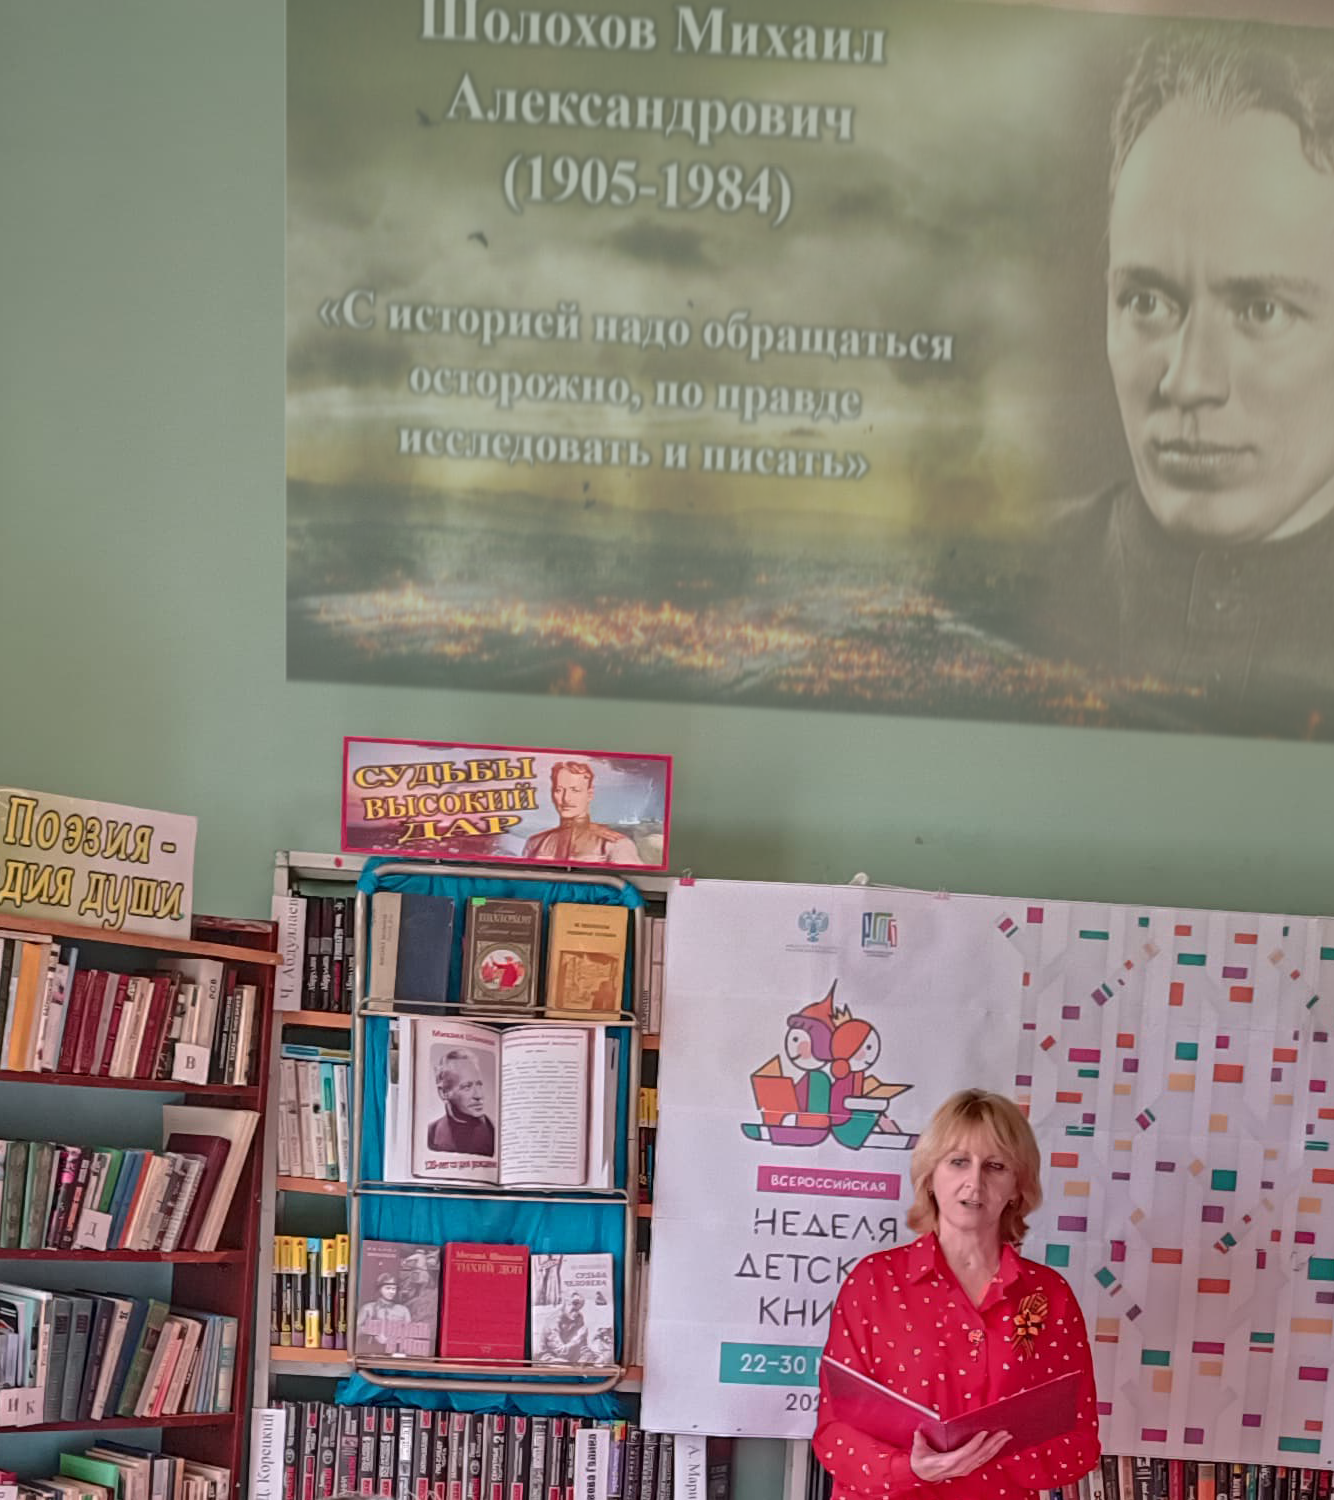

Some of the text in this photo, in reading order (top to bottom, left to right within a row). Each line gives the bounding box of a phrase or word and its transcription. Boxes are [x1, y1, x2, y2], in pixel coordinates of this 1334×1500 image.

[419, 0, 887, 67] Шолохов Михаил
[447, 71, 856, 144] Александрович
[503, 152, 793, 223] (1905-1984)
[318, 289, 955, 366] «С историей надо обращаться
[409, 361, 861, 423] осторожно, по правде
[399, 421, 870, 481] исследовать и писать»
[354, 757, 536, 790] СУДЬБЫ
[363, 786, 538, 820] ВЫСОКИЙ
[4, 795, 153, 864] Поэзия
[398, 814, 523, 844] ДАР
[80, 870, 184, 930] души
[186, 1055, 195, 1069] В
[770, 1174, 887, 1194] ВСЕРОССИЙСКАЯ
[754, 1207, 899, 1243] НЕДЕЛЯ
[734, 1253, 858, 1284] ДЕТСК
[759, 1296, 834, 1327] КНИ
[25, 1400, 36, 1415] К
[785, 1393, 819, 1412] 20
[256, 1414, 277, 1483] Корецкий
